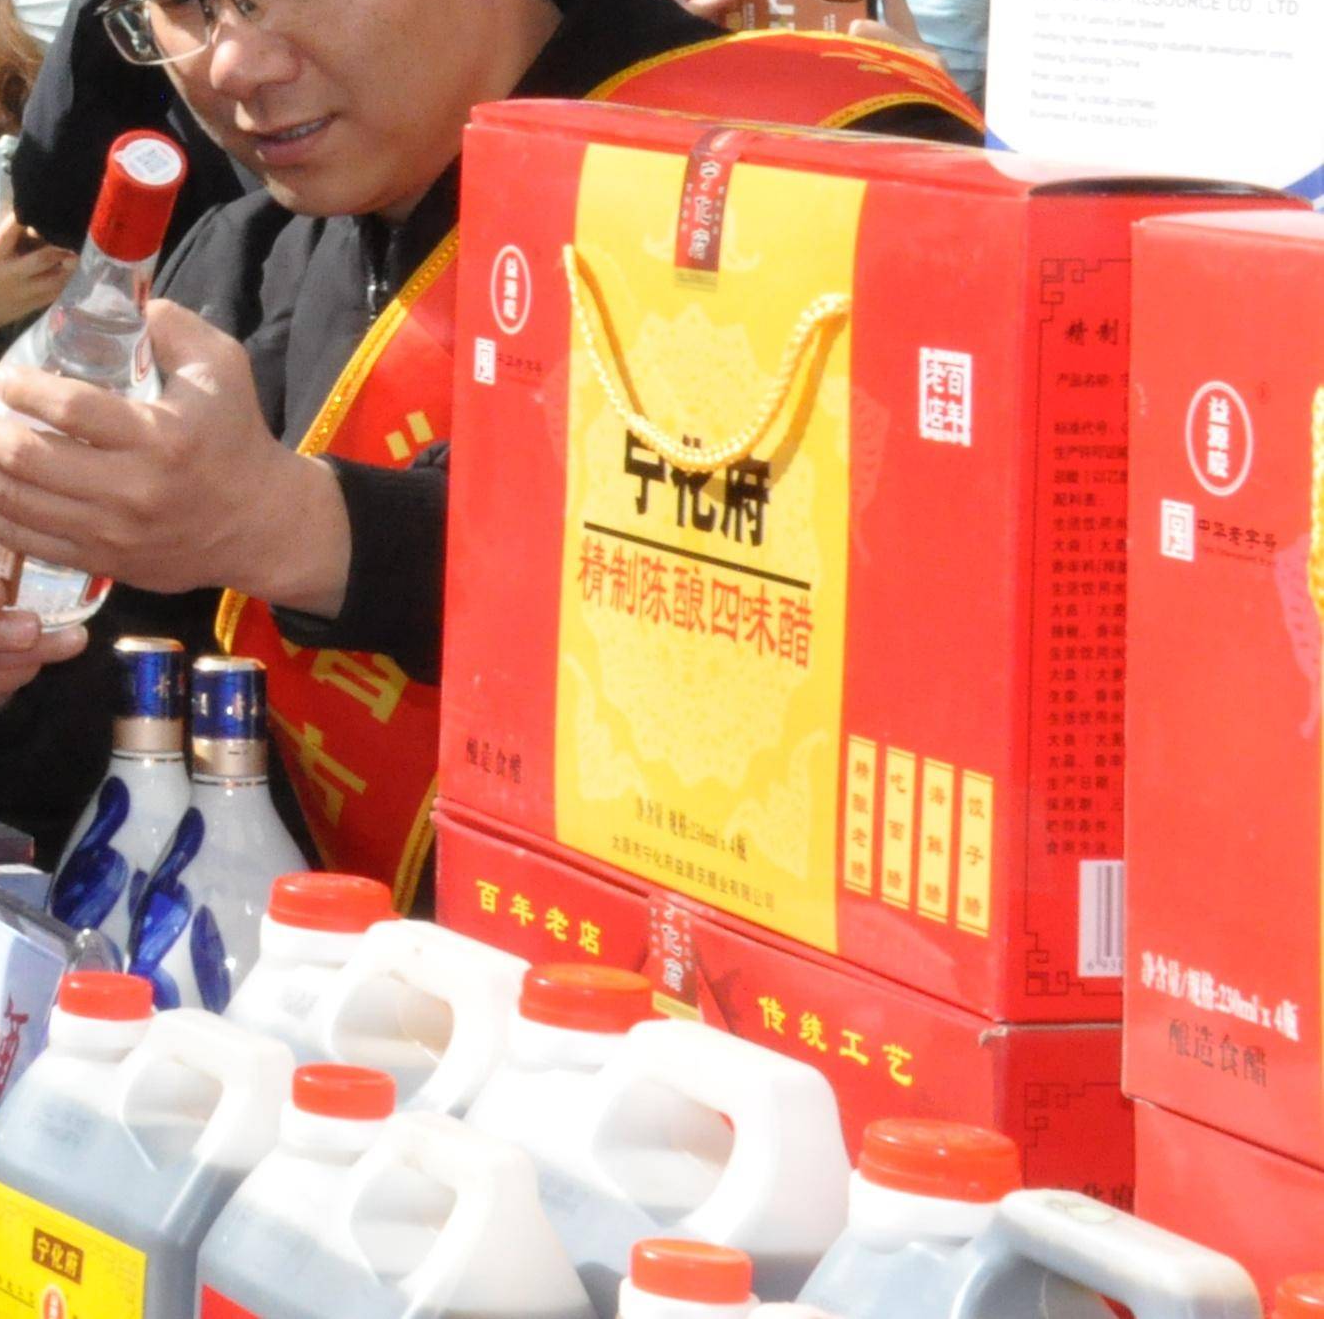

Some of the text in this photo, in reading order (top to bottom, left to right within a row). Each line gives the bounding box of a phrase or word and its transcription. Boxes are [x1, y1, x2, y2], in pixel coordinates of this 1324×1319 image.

[1196, 519, 1278, 554] 中华老字号
[577, 535, 815, 669] 精制陈酿四味醋
[475, 879, 602, 957] 百年老店
[756, 995, 914, 1088] 传统工艺
[1167, 1018, 1268, 1089] 酿造食醋
[35, 1235, 80, 1279] 宁化府
